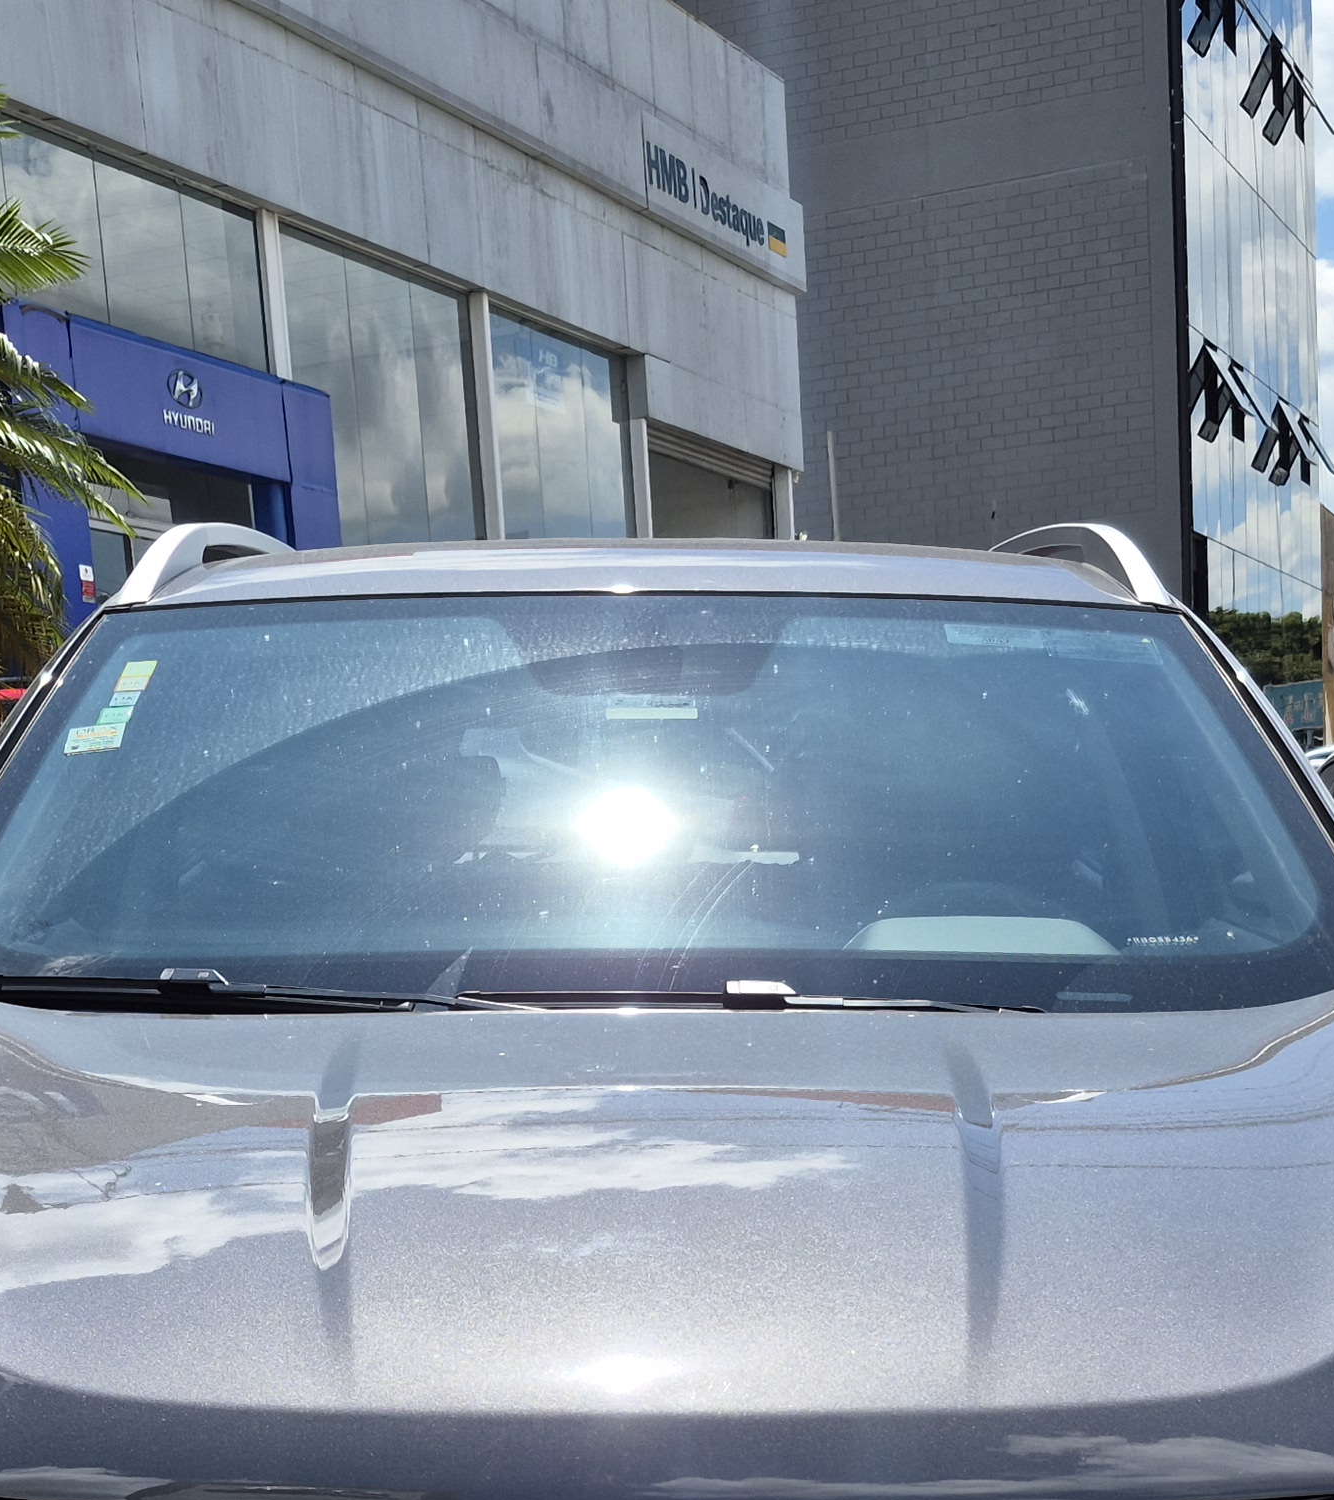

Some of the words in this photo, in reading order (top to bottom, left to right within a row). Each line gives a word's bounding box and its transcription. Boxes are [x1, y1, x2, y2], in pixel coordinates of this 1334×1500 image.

[645, 140, 689, 204] HMB
[699, 175, 765, 247] Destaque
[162, 408, 215, 436] HYUNDAI
